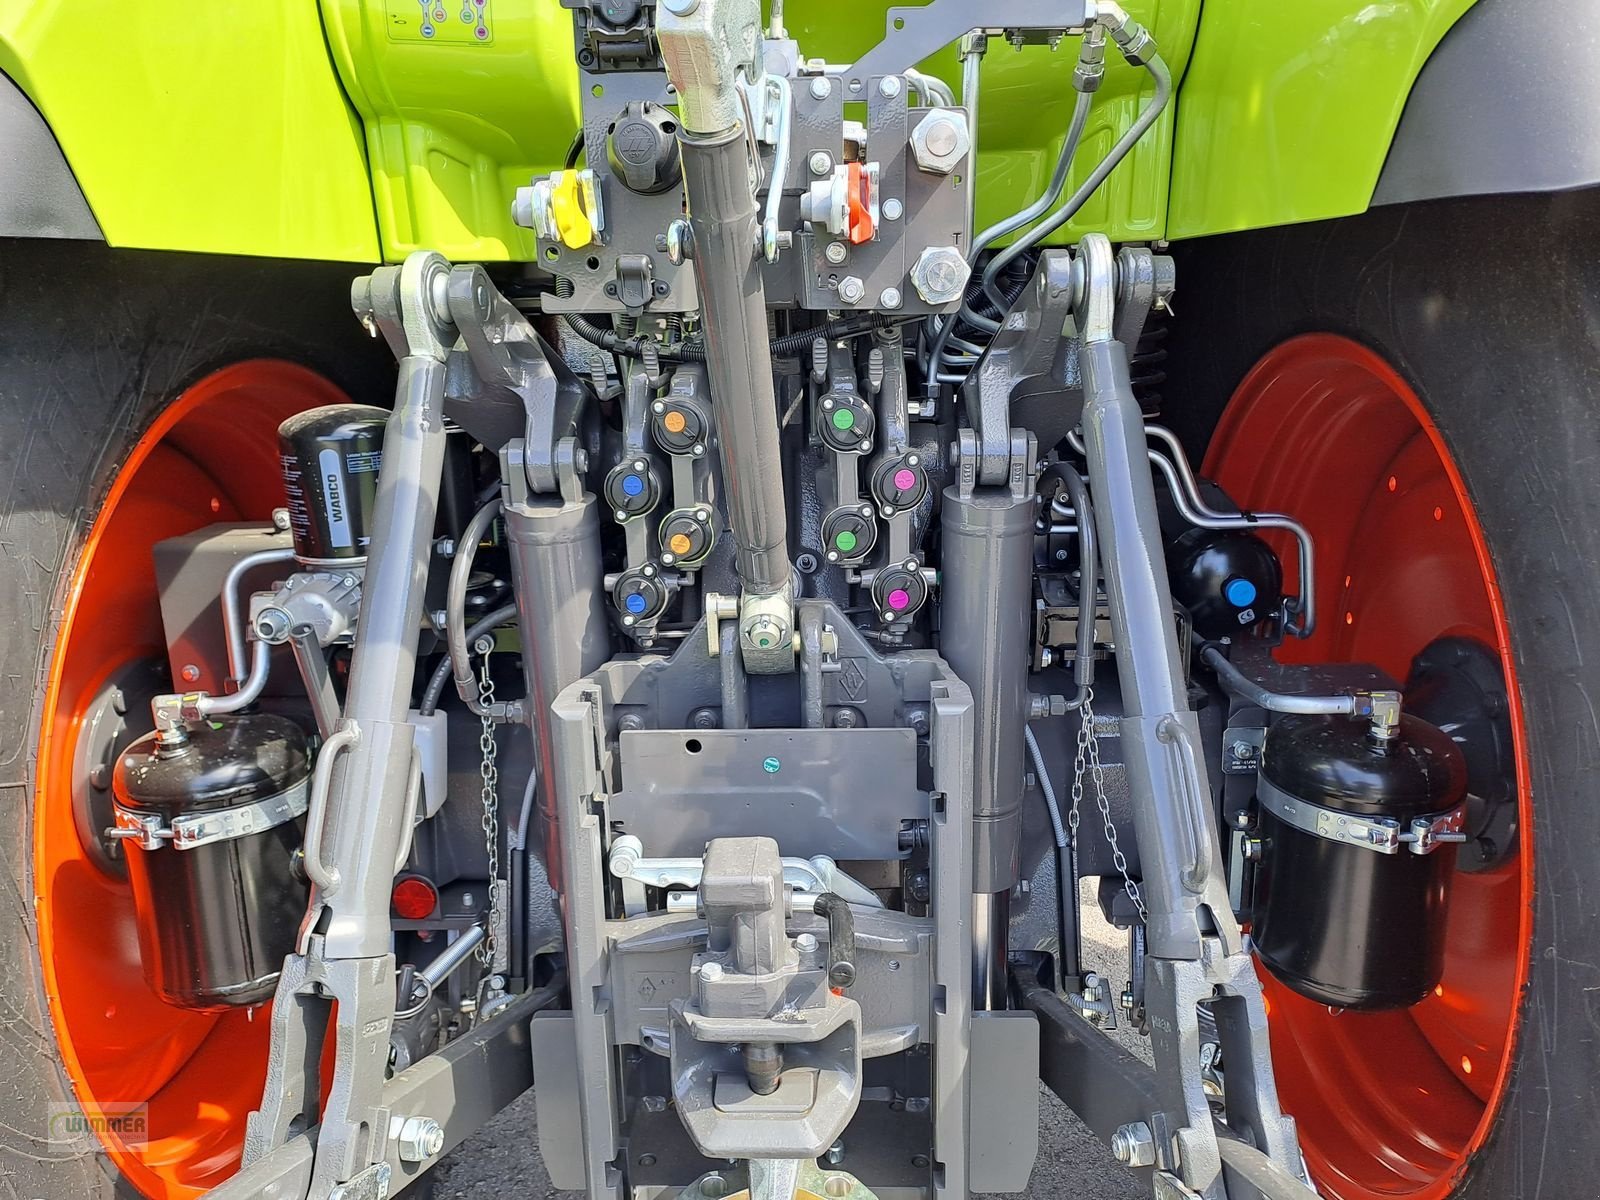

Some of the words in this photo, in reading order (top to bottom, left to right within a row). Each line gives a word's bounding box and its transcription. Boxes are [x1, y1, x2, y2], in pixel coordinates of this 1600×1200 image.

[953, 175, 962, 190] P
[952, 232, 962, 246] T
[817, 273, 839, 291] LS
[327, 474, 343, 523] WABCO
